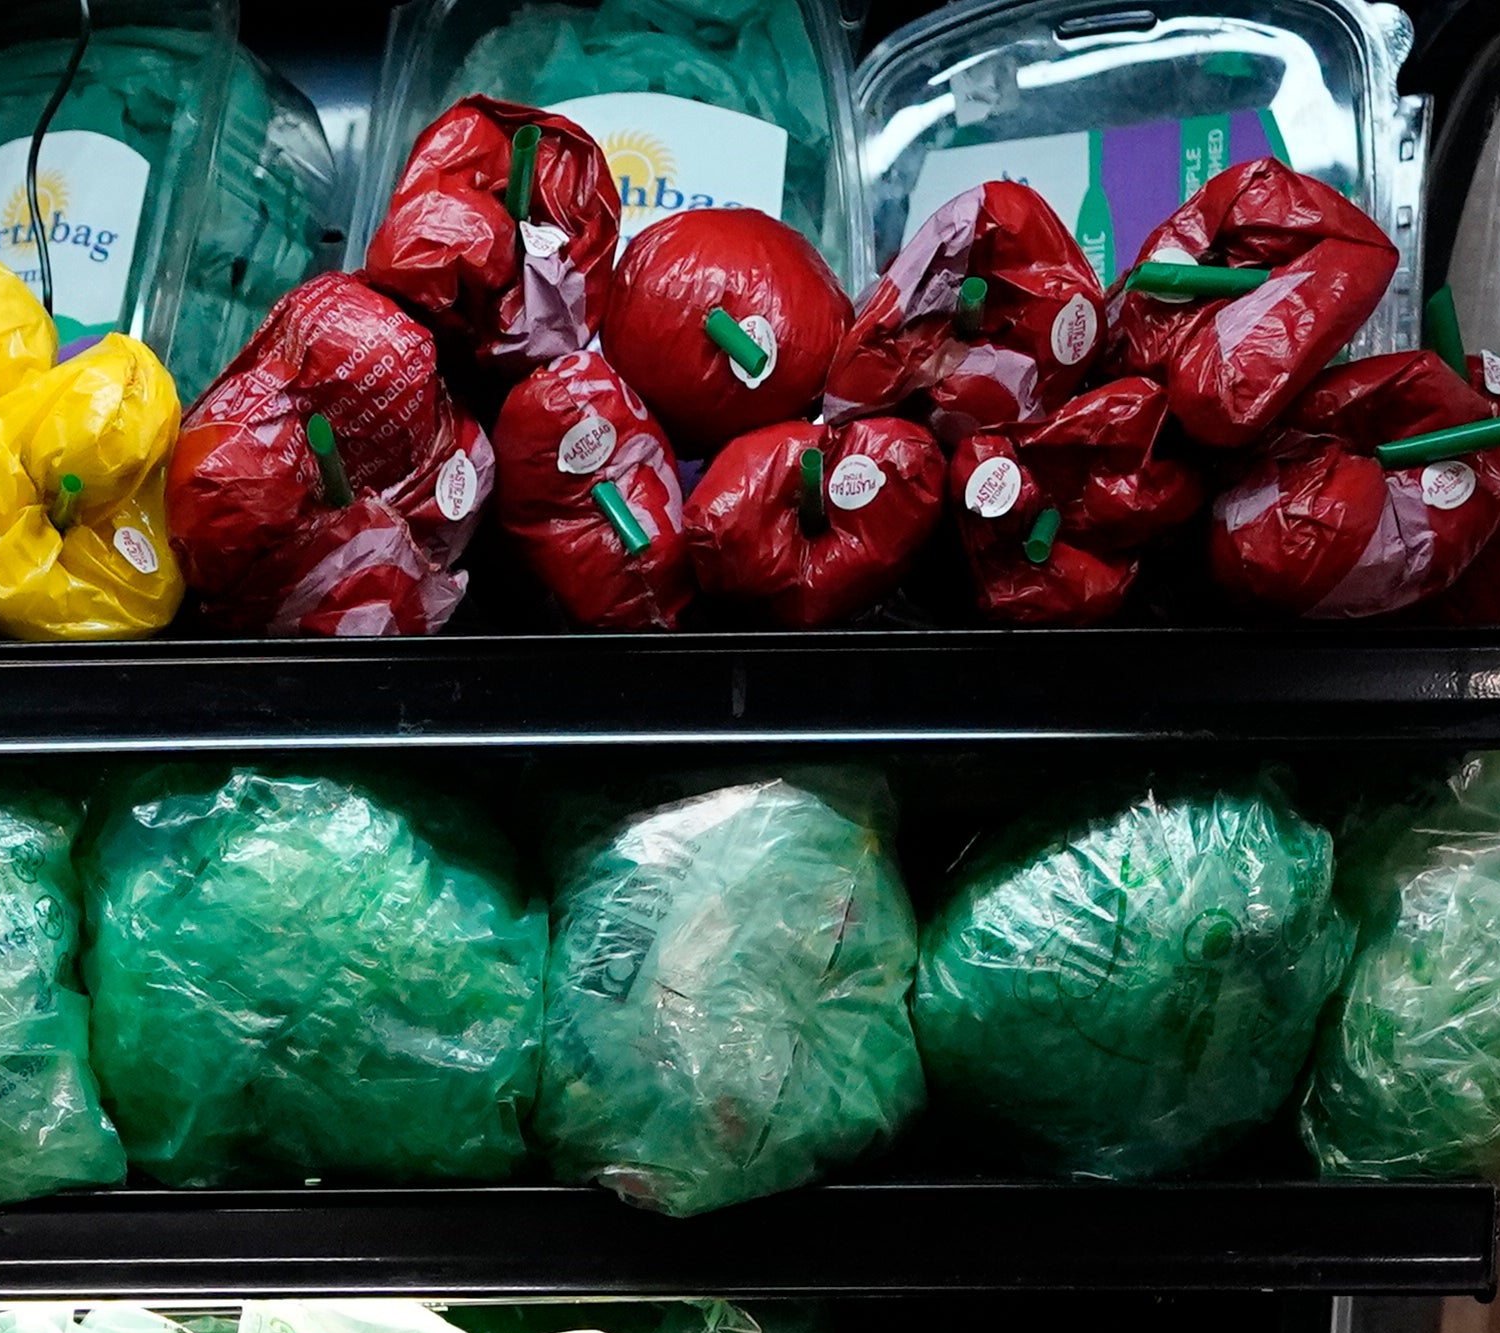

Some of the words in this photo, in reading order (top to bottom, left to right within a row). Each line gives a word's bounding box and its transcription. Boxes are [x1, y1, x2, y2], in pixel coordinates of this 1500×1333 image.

[335, 334, 378, 380] avoid
[356, 352, 396, 394] keep
[563, 433, 594, 465] PLASTIC
